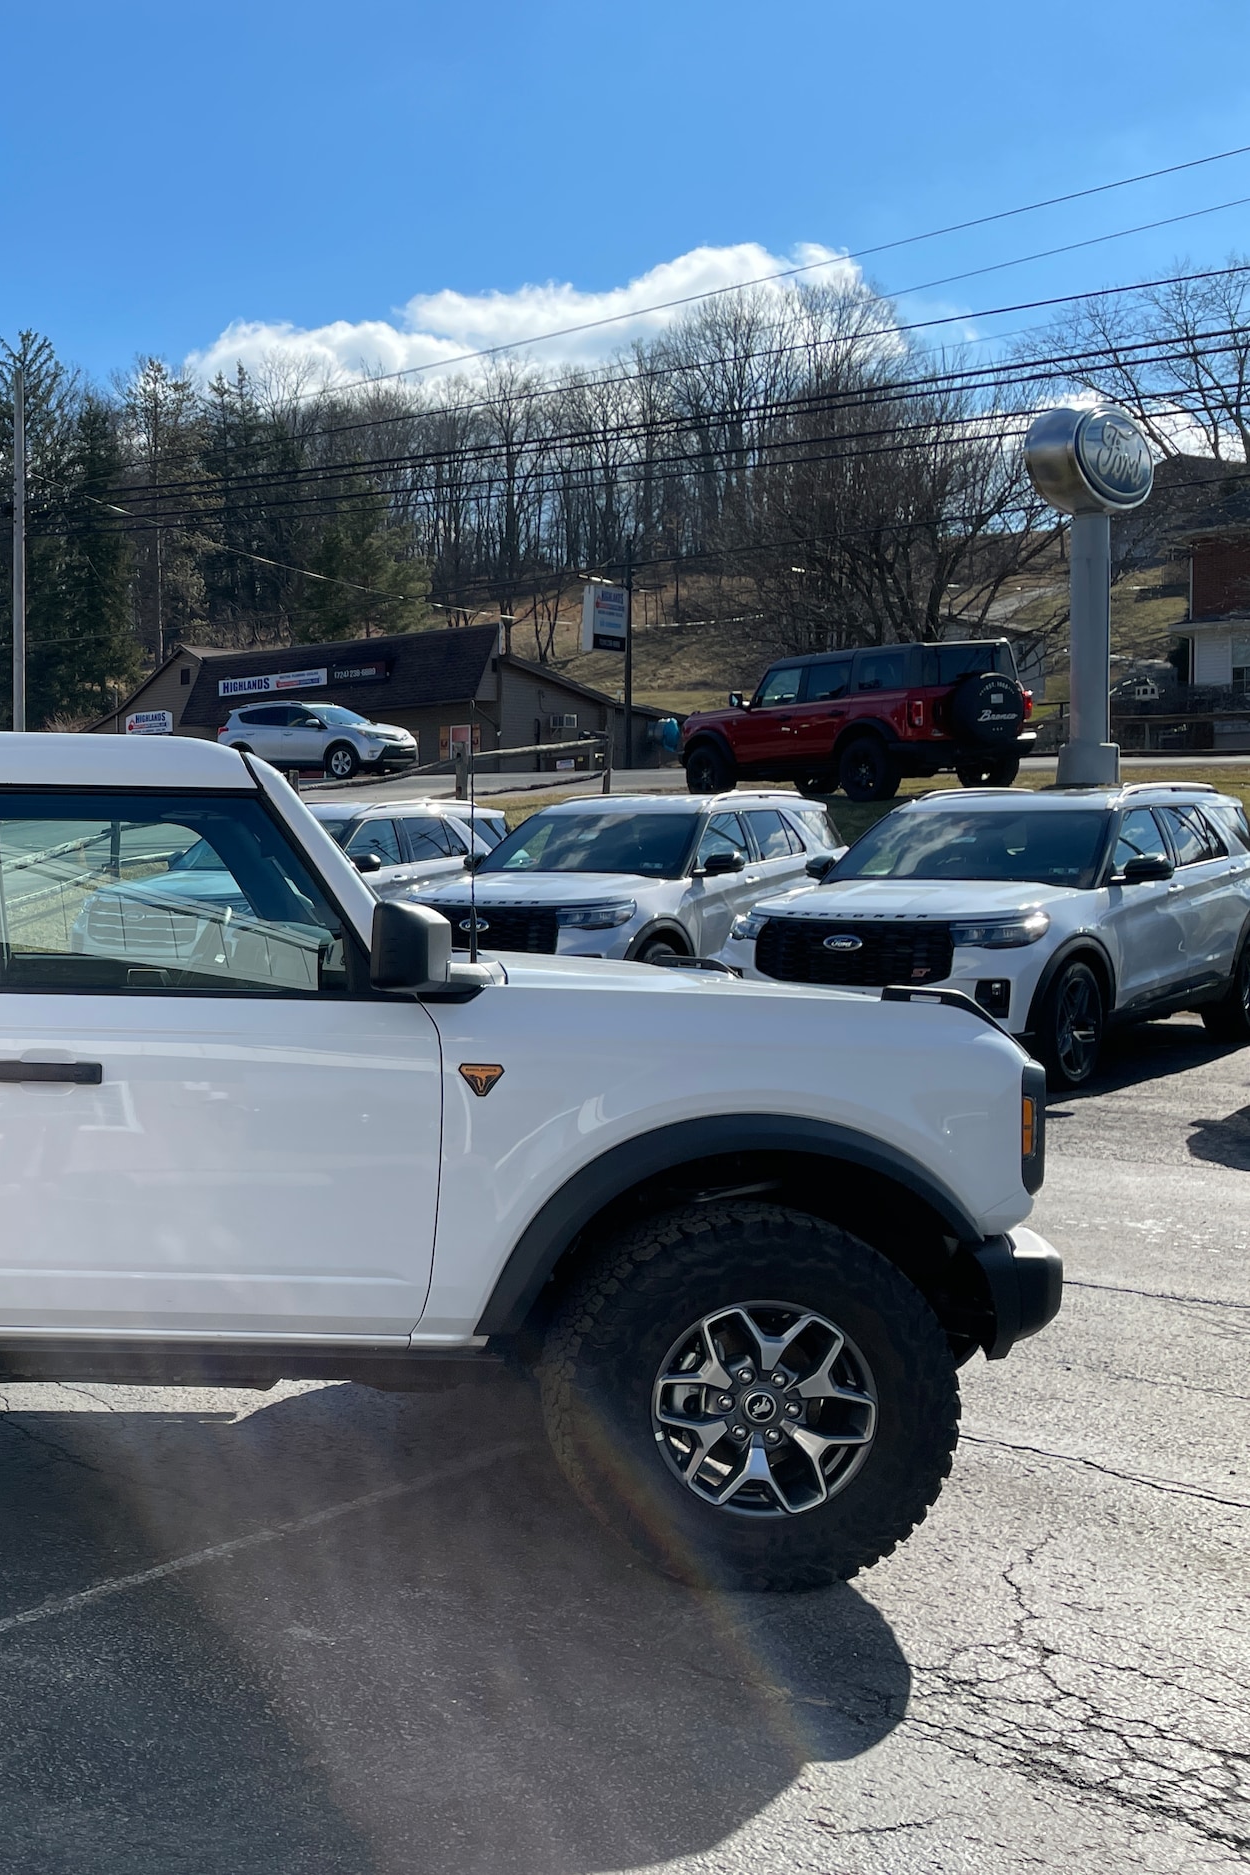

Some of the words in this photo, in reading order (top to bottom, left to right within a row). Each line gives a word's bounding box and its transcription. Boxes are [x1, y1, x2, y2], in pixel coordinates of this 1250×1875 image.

[1097, 421, 1144, 486] Ford
[222, 677, 270, 694] HIGHLANDS
[135, 712, 166, 723] HIGHLANDS
[977, 709, 1018, 722] Bronco
[786, 911, 928, 919] EXPLORER
[911, 967, 931, 977] ST
